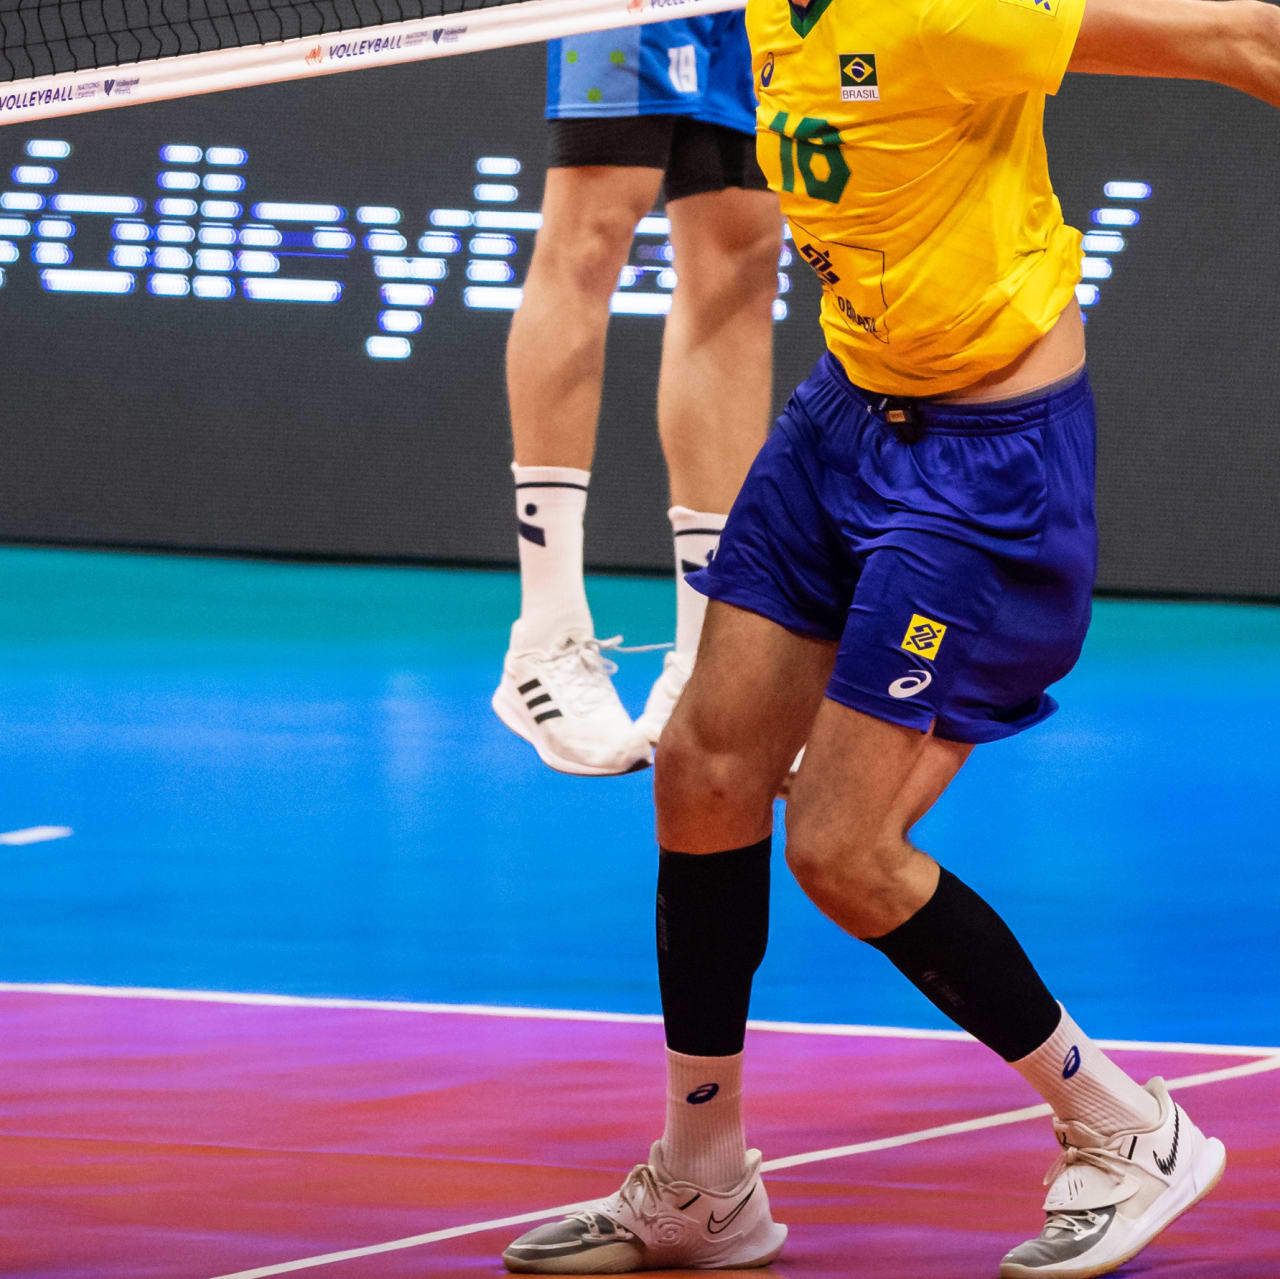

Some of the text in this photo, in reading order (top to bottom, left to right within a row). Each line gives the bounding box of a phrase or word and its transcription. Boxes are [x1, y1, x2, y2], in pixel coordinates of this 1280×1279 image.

[329, 35, 402, 59] VOLLEYBALL
[842, 88, 878, 101] BRASIL
[768, 111, 852, 205] 16
